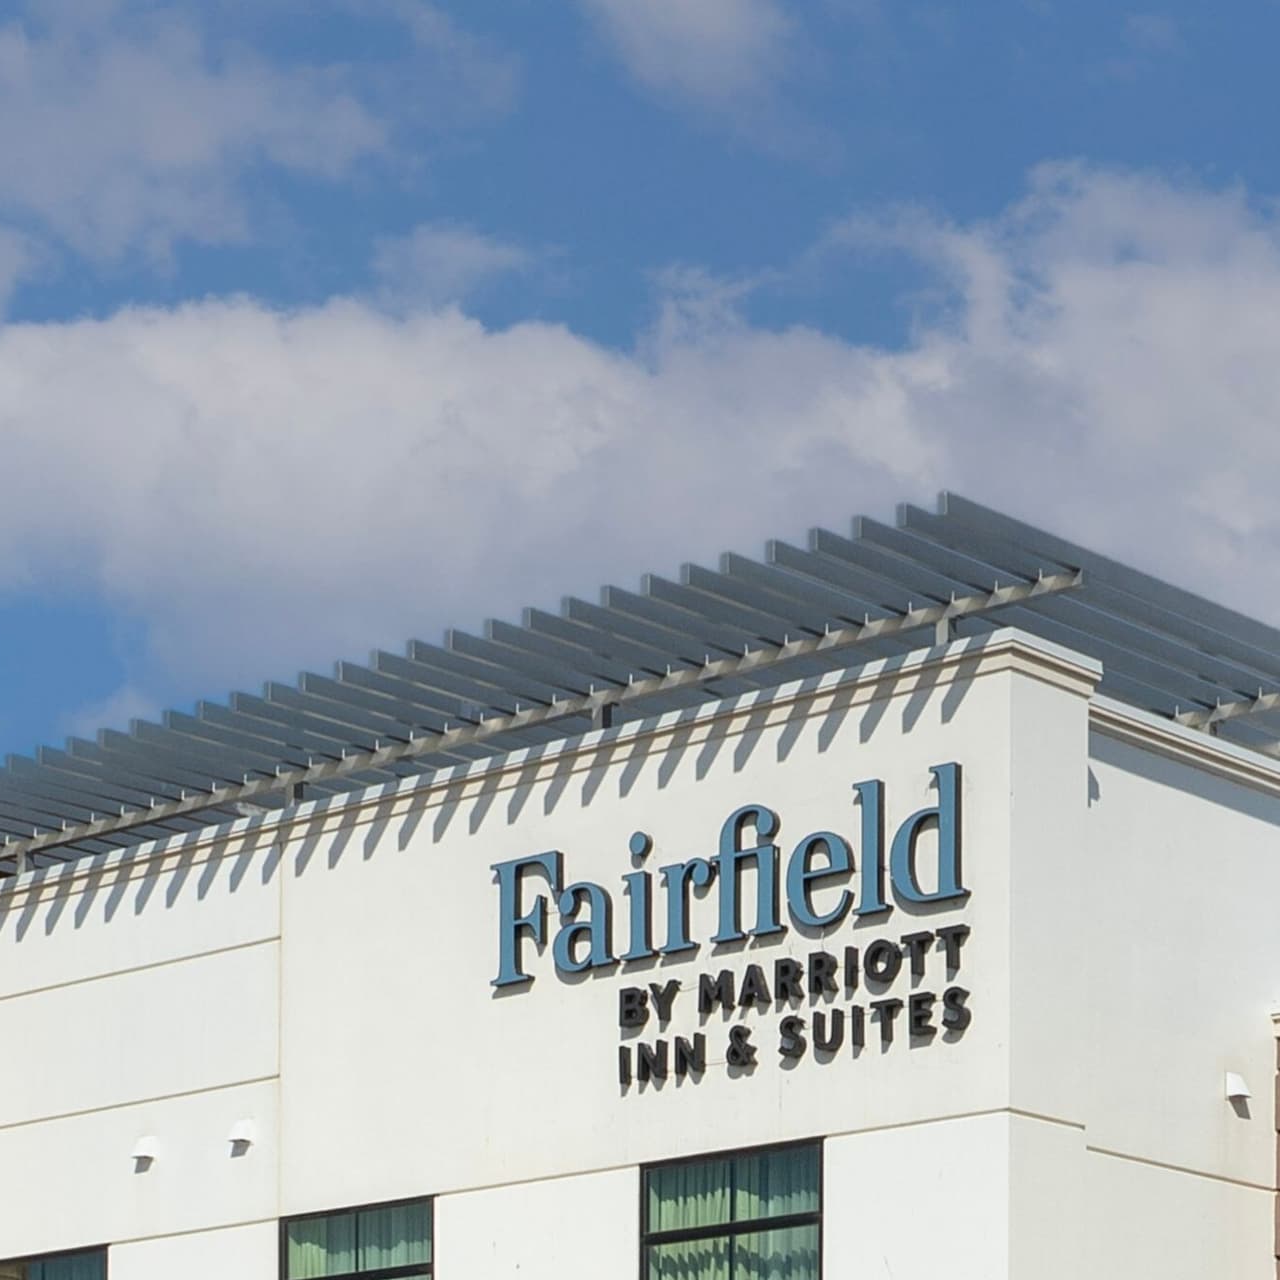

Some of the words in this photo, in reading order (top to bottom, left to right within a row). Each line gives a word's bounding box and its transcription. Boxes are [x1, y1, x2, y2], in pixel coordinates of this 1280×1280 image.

[489, 761, 971, 988] Fairfield
[619, 979, 682, 1028] BY
[698, 924, 971, 1014] MARRIOTT
[619, 1033, 706, 1086] INN
[726, 1025, 758, 1067] &
[778, 986, 972, 1059] SUITES
